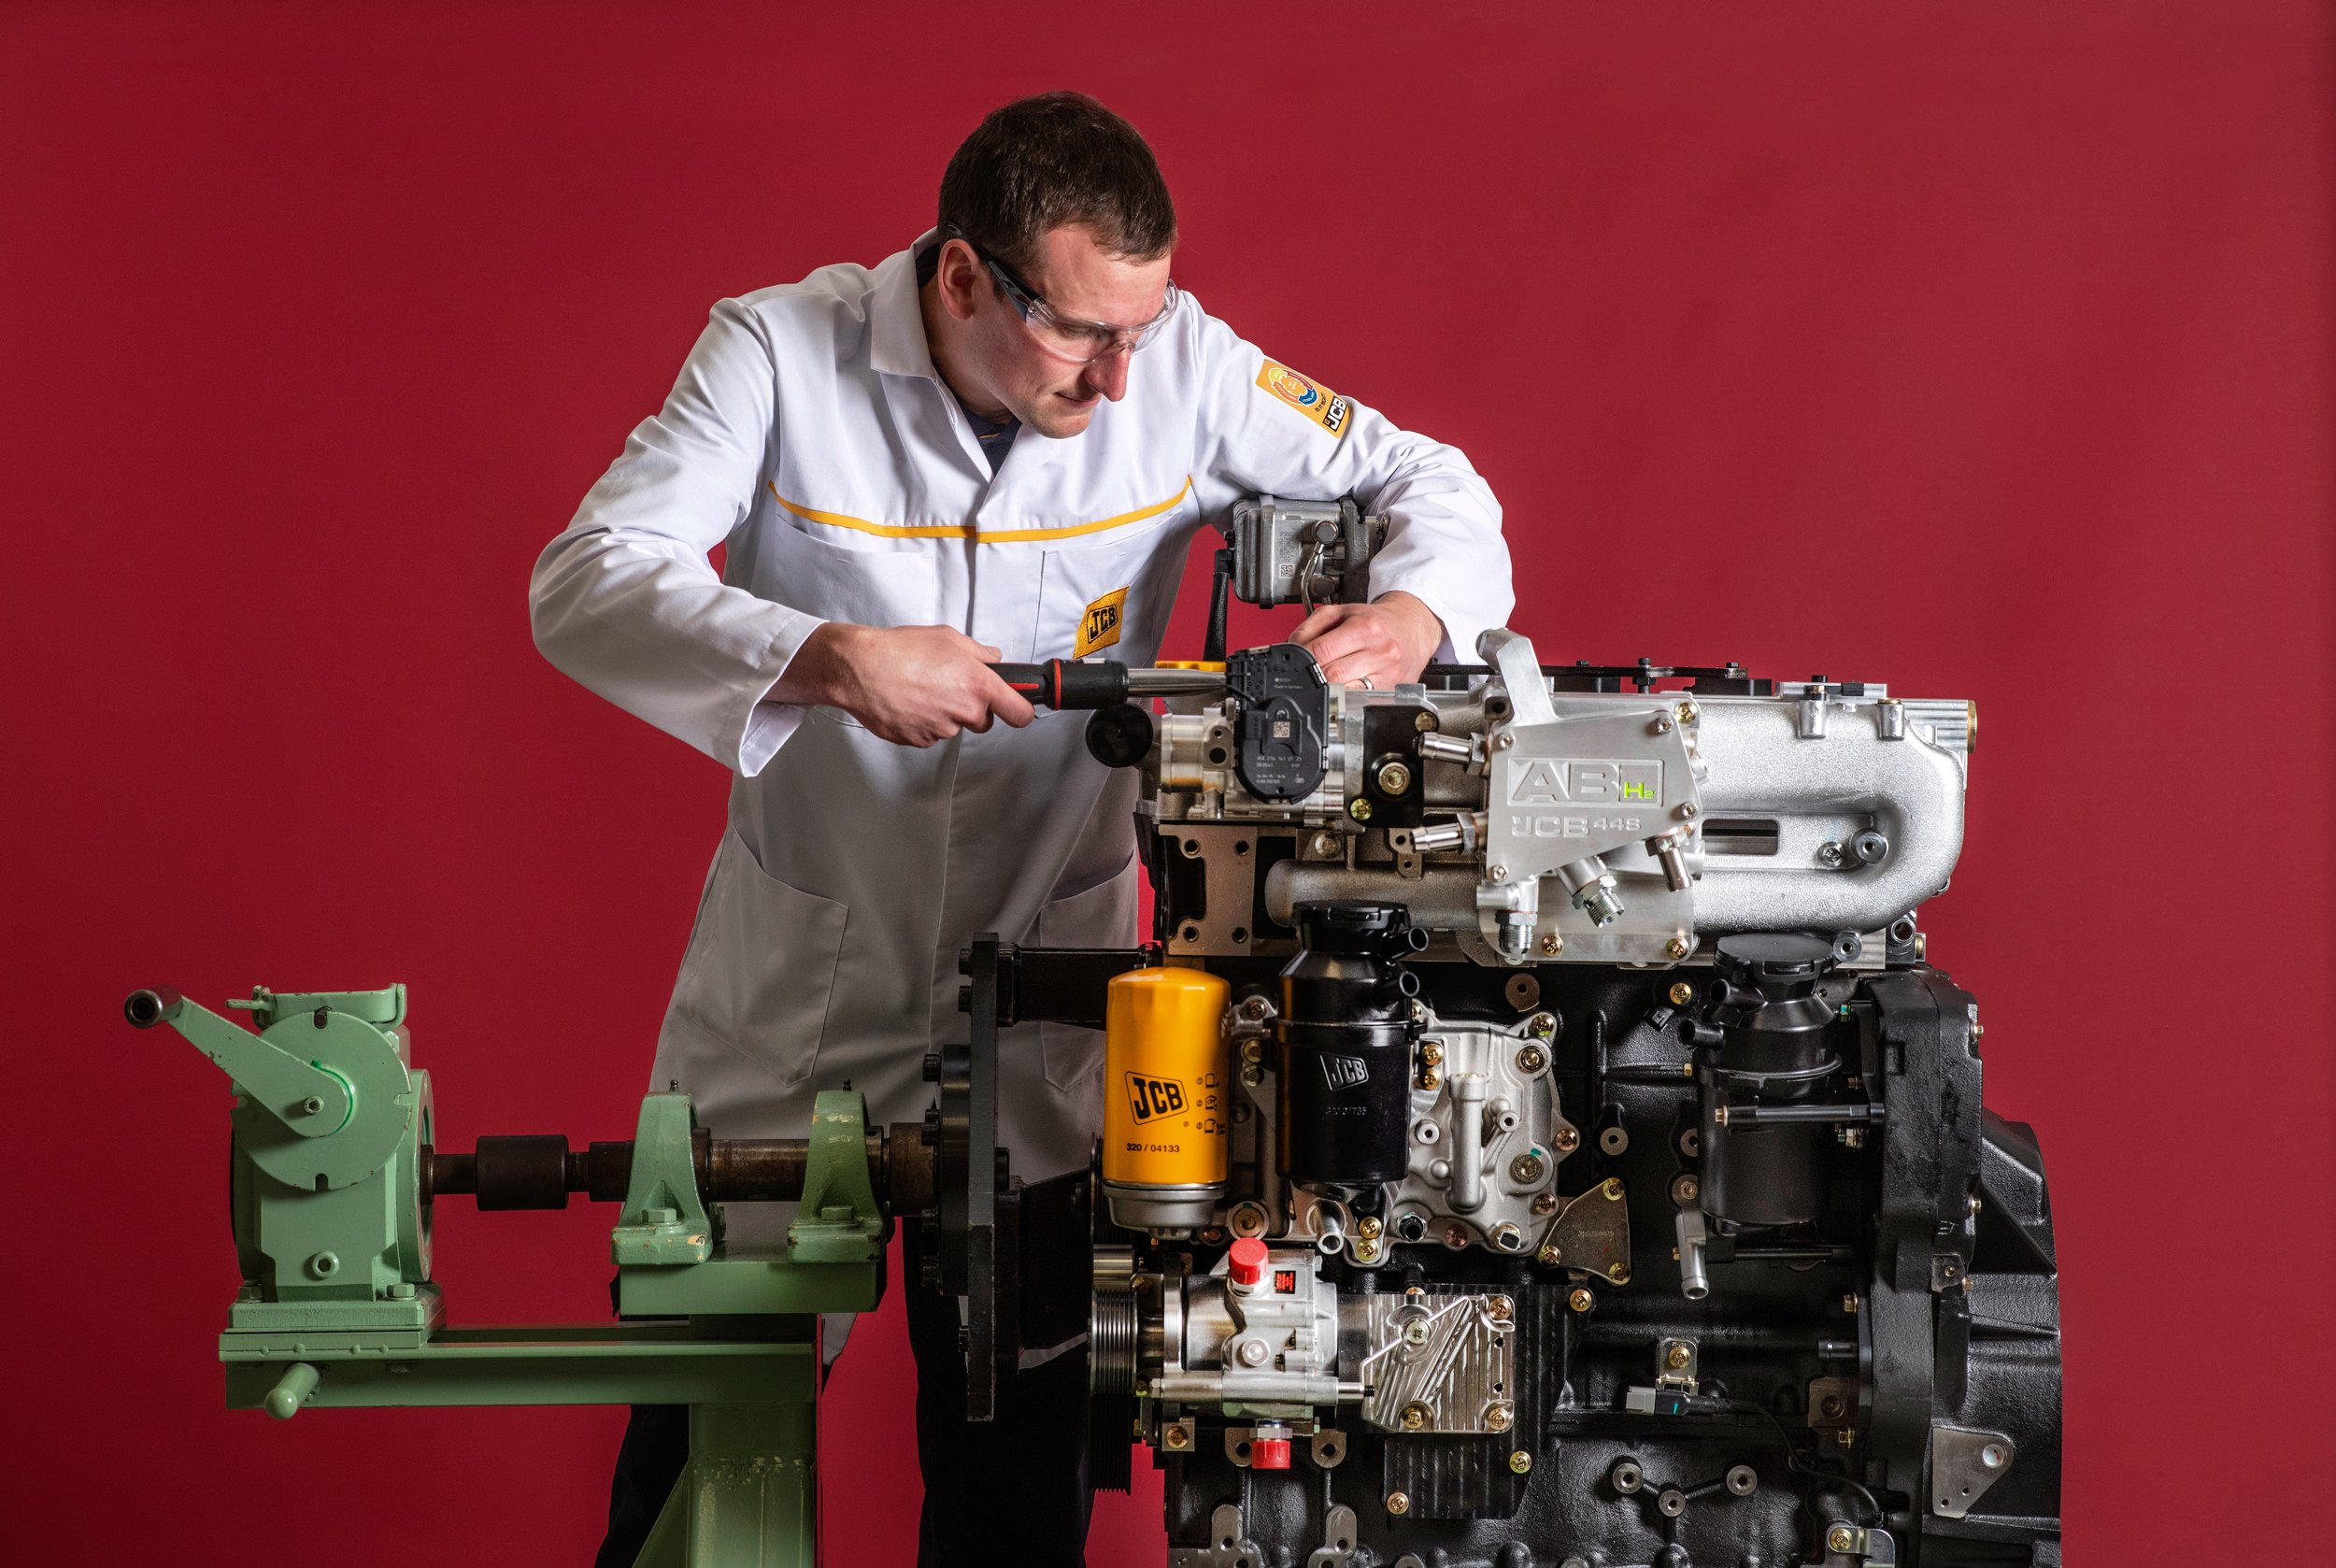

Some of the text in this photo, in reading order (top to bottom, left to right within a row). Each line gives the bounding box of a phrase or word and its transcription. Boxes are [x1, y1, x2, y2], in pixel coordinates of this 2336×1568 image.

[1327, 397, 1346, 430] JCB
[1090, 606, 1117, 640] JCB
[1512, 816, 1641, 837] JCB 448
[1330, 1057, 1365, 1086] JCB
[1132, 1076, 1183, 1119] JCB
[1126, 1143, 1142, 1151] 320
